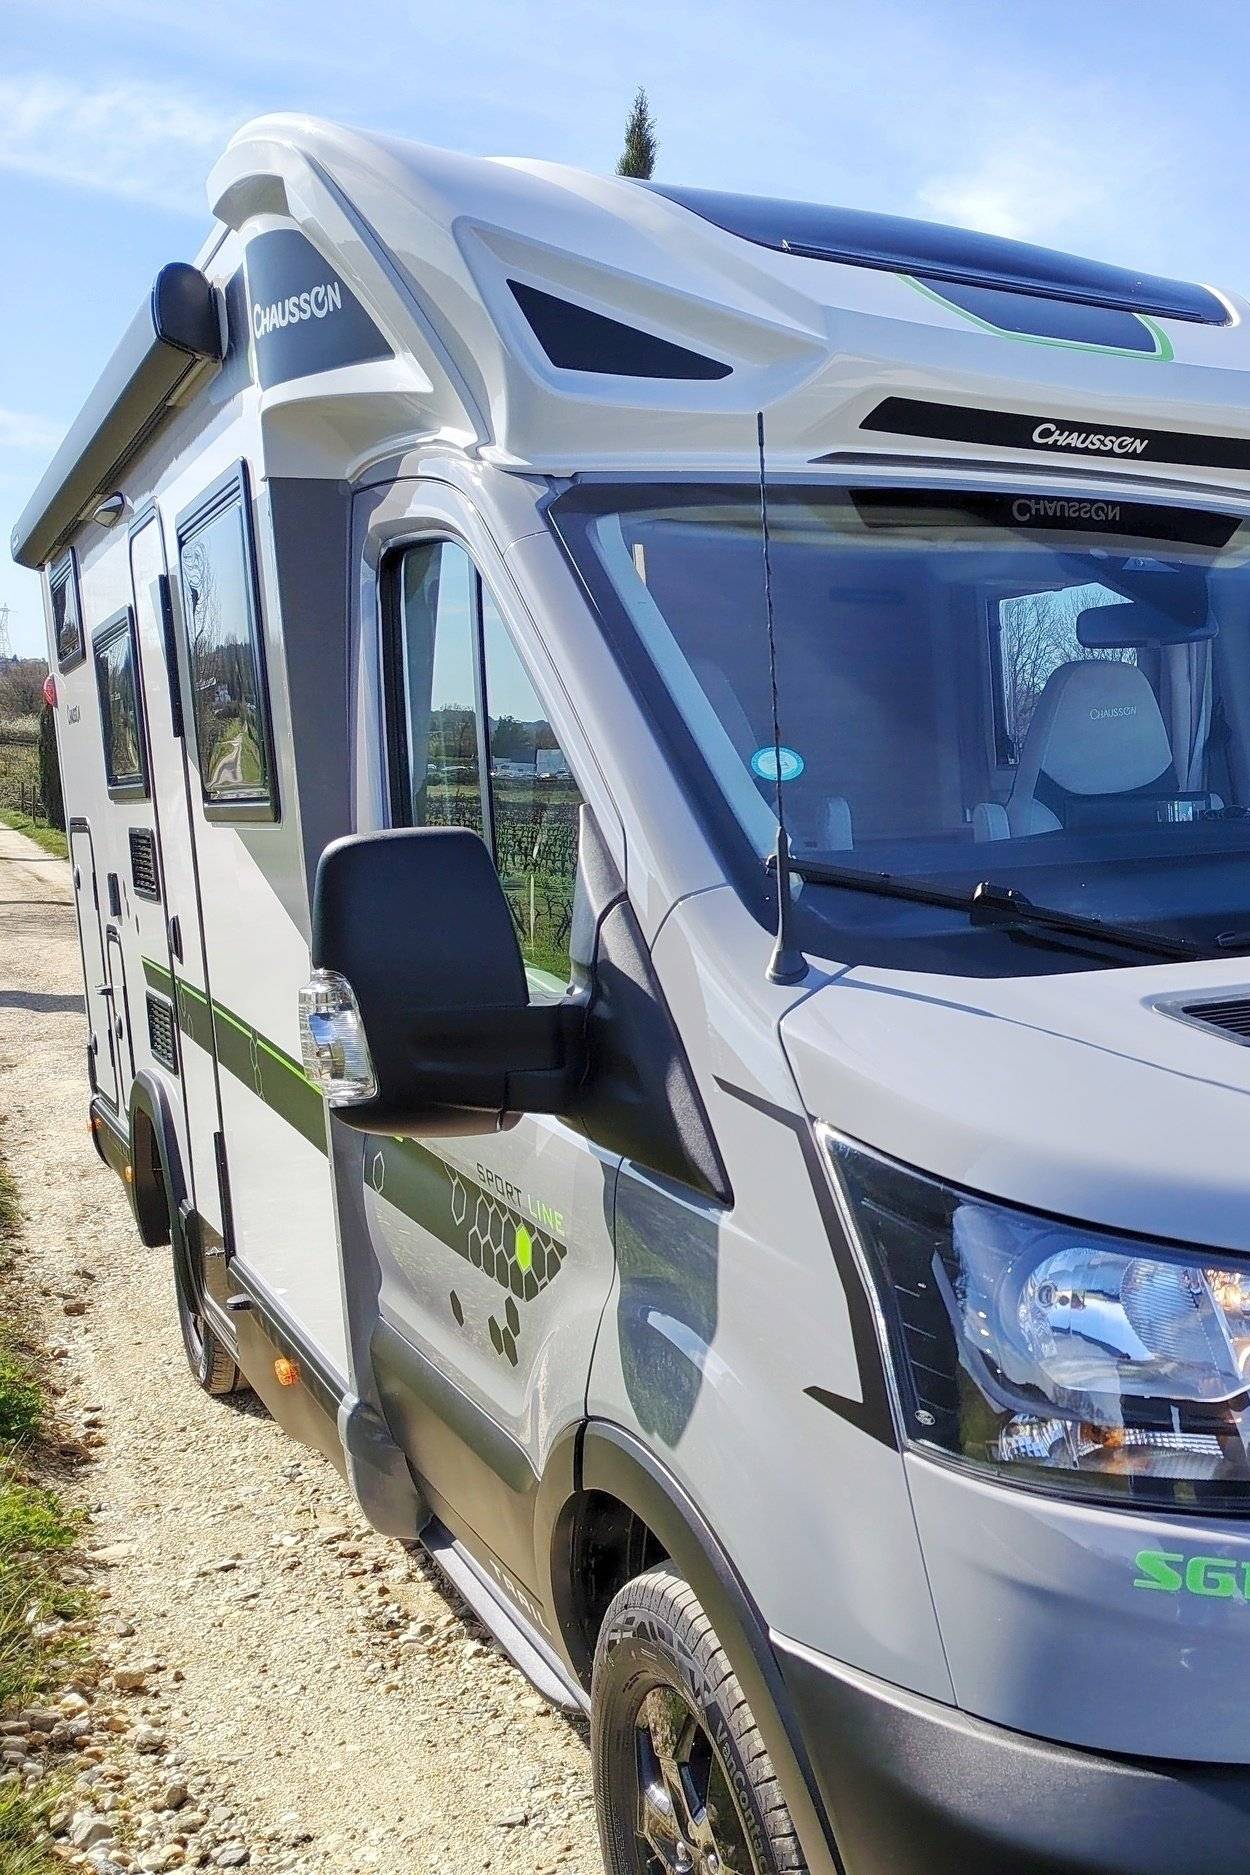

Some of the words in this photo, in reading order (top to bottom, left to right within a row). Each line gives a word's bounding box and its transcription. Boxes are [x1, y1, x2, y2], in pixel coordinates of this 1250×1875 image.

[253, 281, 342, 339] CHAUSSON
[1031, 423, 1149, 454] CHAUSSON
[1089, 705, 1137, 720] CHAUSSON
[476, 1162, 522, 1208] SPORT
[527, 1193, 566, 1236] LINE
